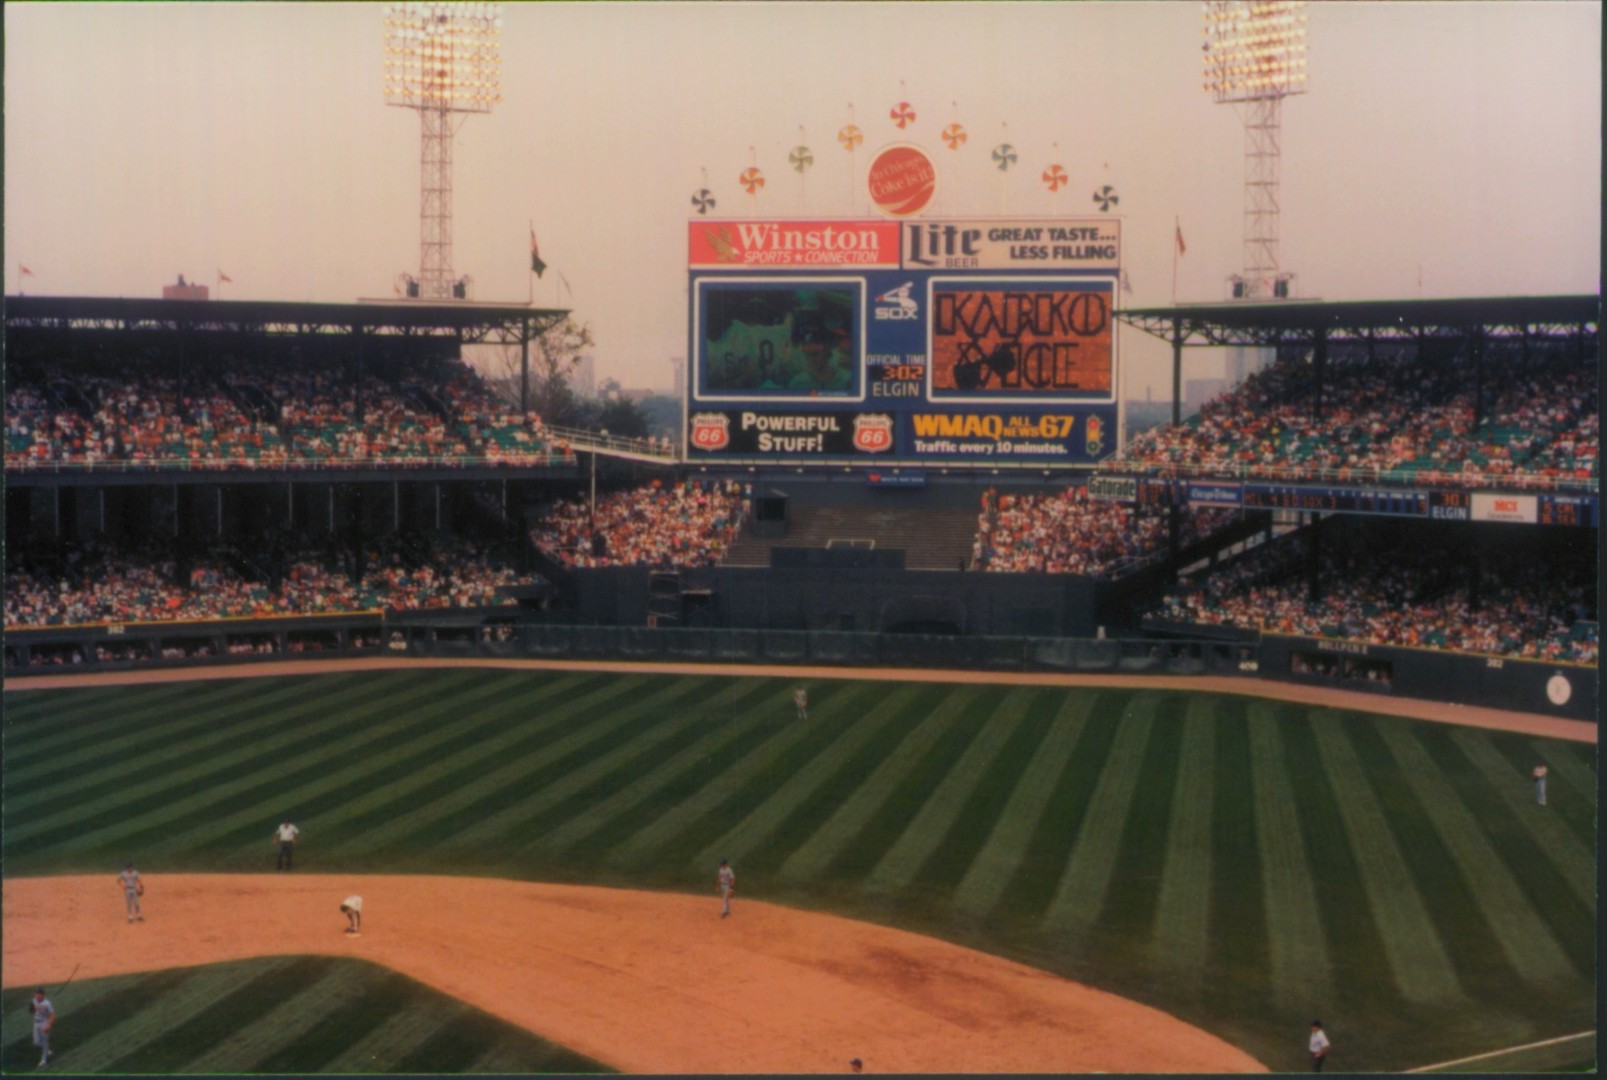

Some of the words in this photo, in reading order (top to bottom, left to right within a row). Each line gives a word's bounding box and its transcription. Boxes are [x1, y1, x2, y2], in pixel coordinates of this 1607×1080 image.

[737, 223, 879, 250] Winston
[988, 228, 1043, 241] GREAT
[1048, 228, 1116, 241] TASTE...
[907, 224, 982, 267] Lite
[744, 251, 791, 263] SPORTS
[805, 251, 879, 263] CONNECTION
[1010, 246, 1048, 260] LESS
[1053, 246, 1116, 260] FILLING
[946, 257, 979, 268] BEER
[875, 308, 918, 319] SOX
[867, 354, 902, 366] OFFICIAL
[906, 354, 926, 366] TIME
[872, 382, 920, 397] ELGIN
[913, 414, 1003, 440] WMAQ
[1009, 416, 1032, 427] ALL
[1039, 415, 1075, 438] 67
[699, 428, 720, 442] 66
[861, 430, 883, 444] 66
[1004, 427, 1039, 437] NEWS
[914, 441, 957, 453] Traffic
[959, 443, 993, 455] every
[997, 442, 1012, 453] 10
[1014, 442, 1068, 454] minutes.
[1088, 478, 1136, 497] Gatorade
[1433, 506, 1467, 520] ELGIN
[1494, 500, 1518, 512] MCI
